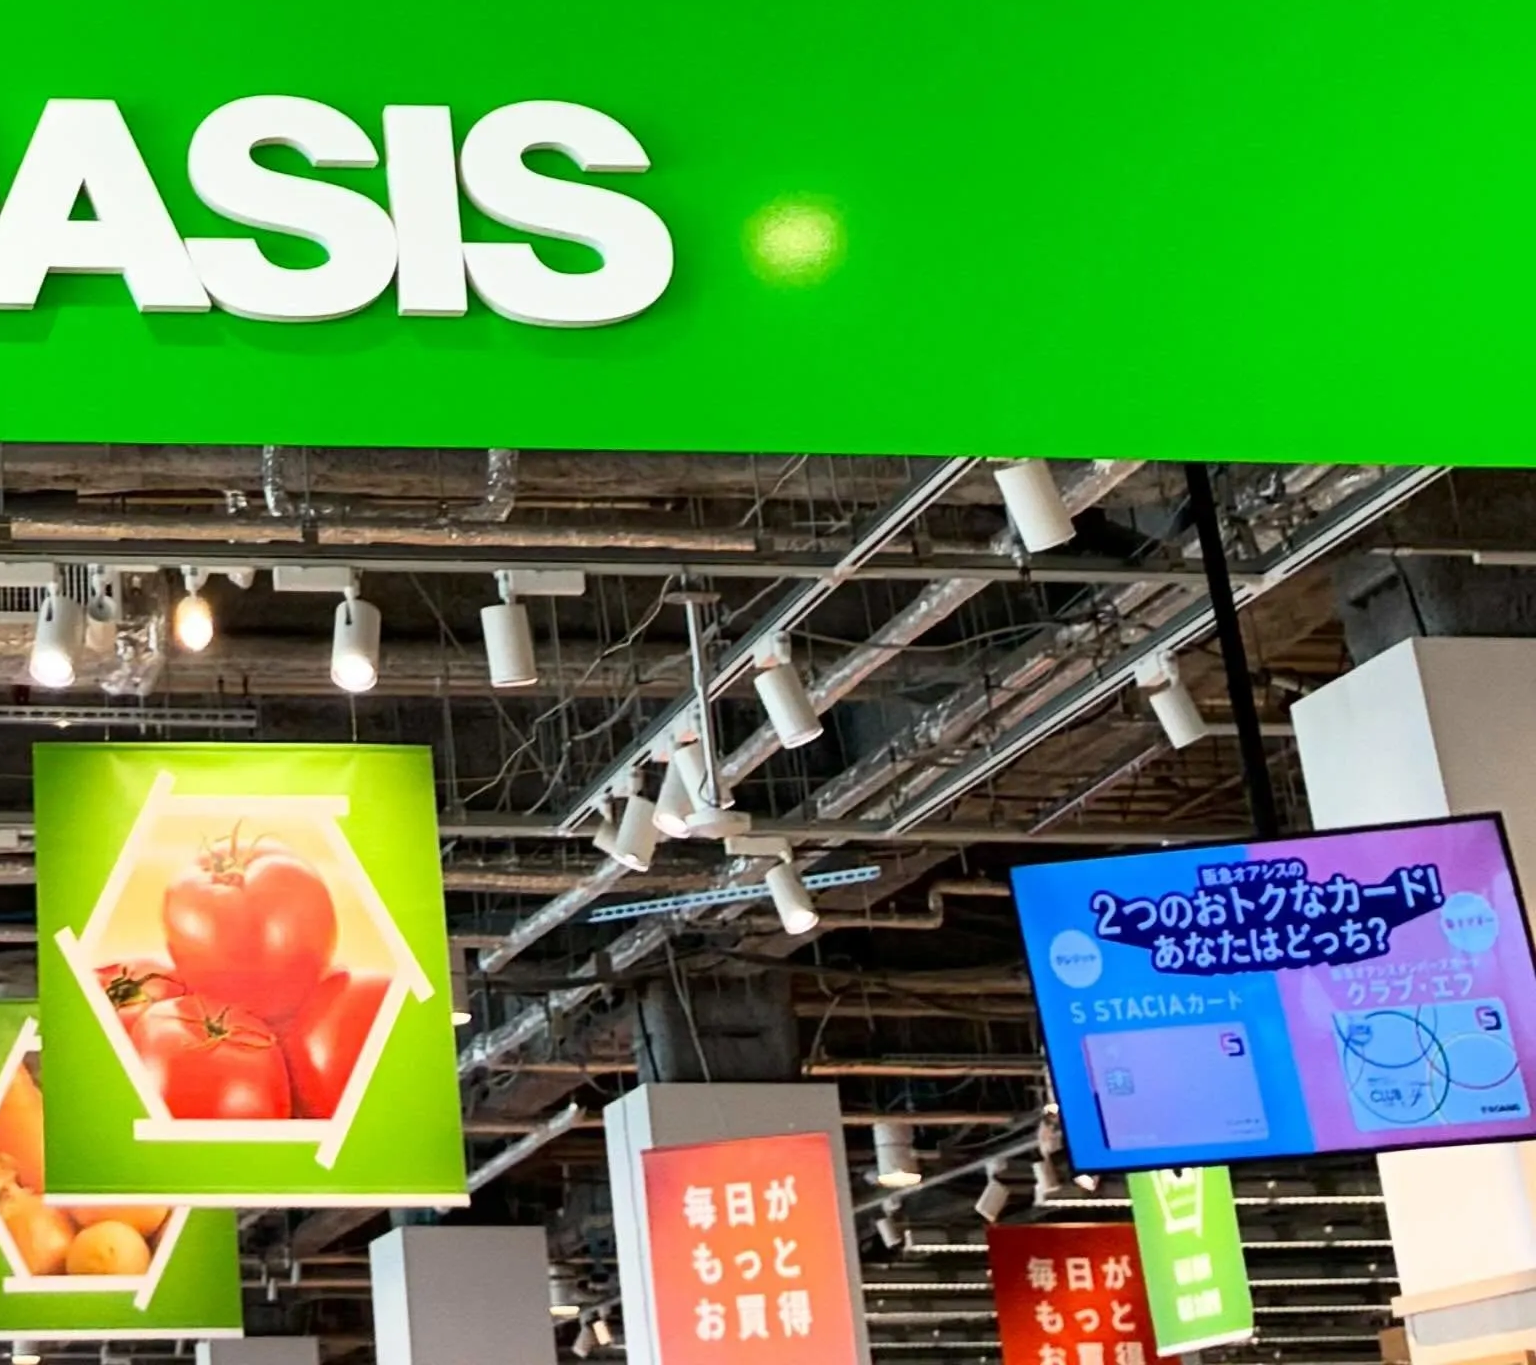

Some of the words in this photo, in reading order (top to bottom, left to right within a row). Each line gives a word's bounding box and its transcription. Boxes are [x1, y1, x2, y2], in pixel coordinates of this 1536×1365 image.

[1153, 917, 1388, 969] あなたはどっち?
[1070, 1001, 1087, 1025] S
[1093, 988, 1244, 1023] STACIAカード
[682, 1174, 799, 1232] 毎日が
[692, 1235, 802, 1286] もっと
[1026, 1254, 1133, 1293] 毎日が
[693, 1289, 814, 1342] お買得
[1034, 1300, 1137, 1335] もっと
